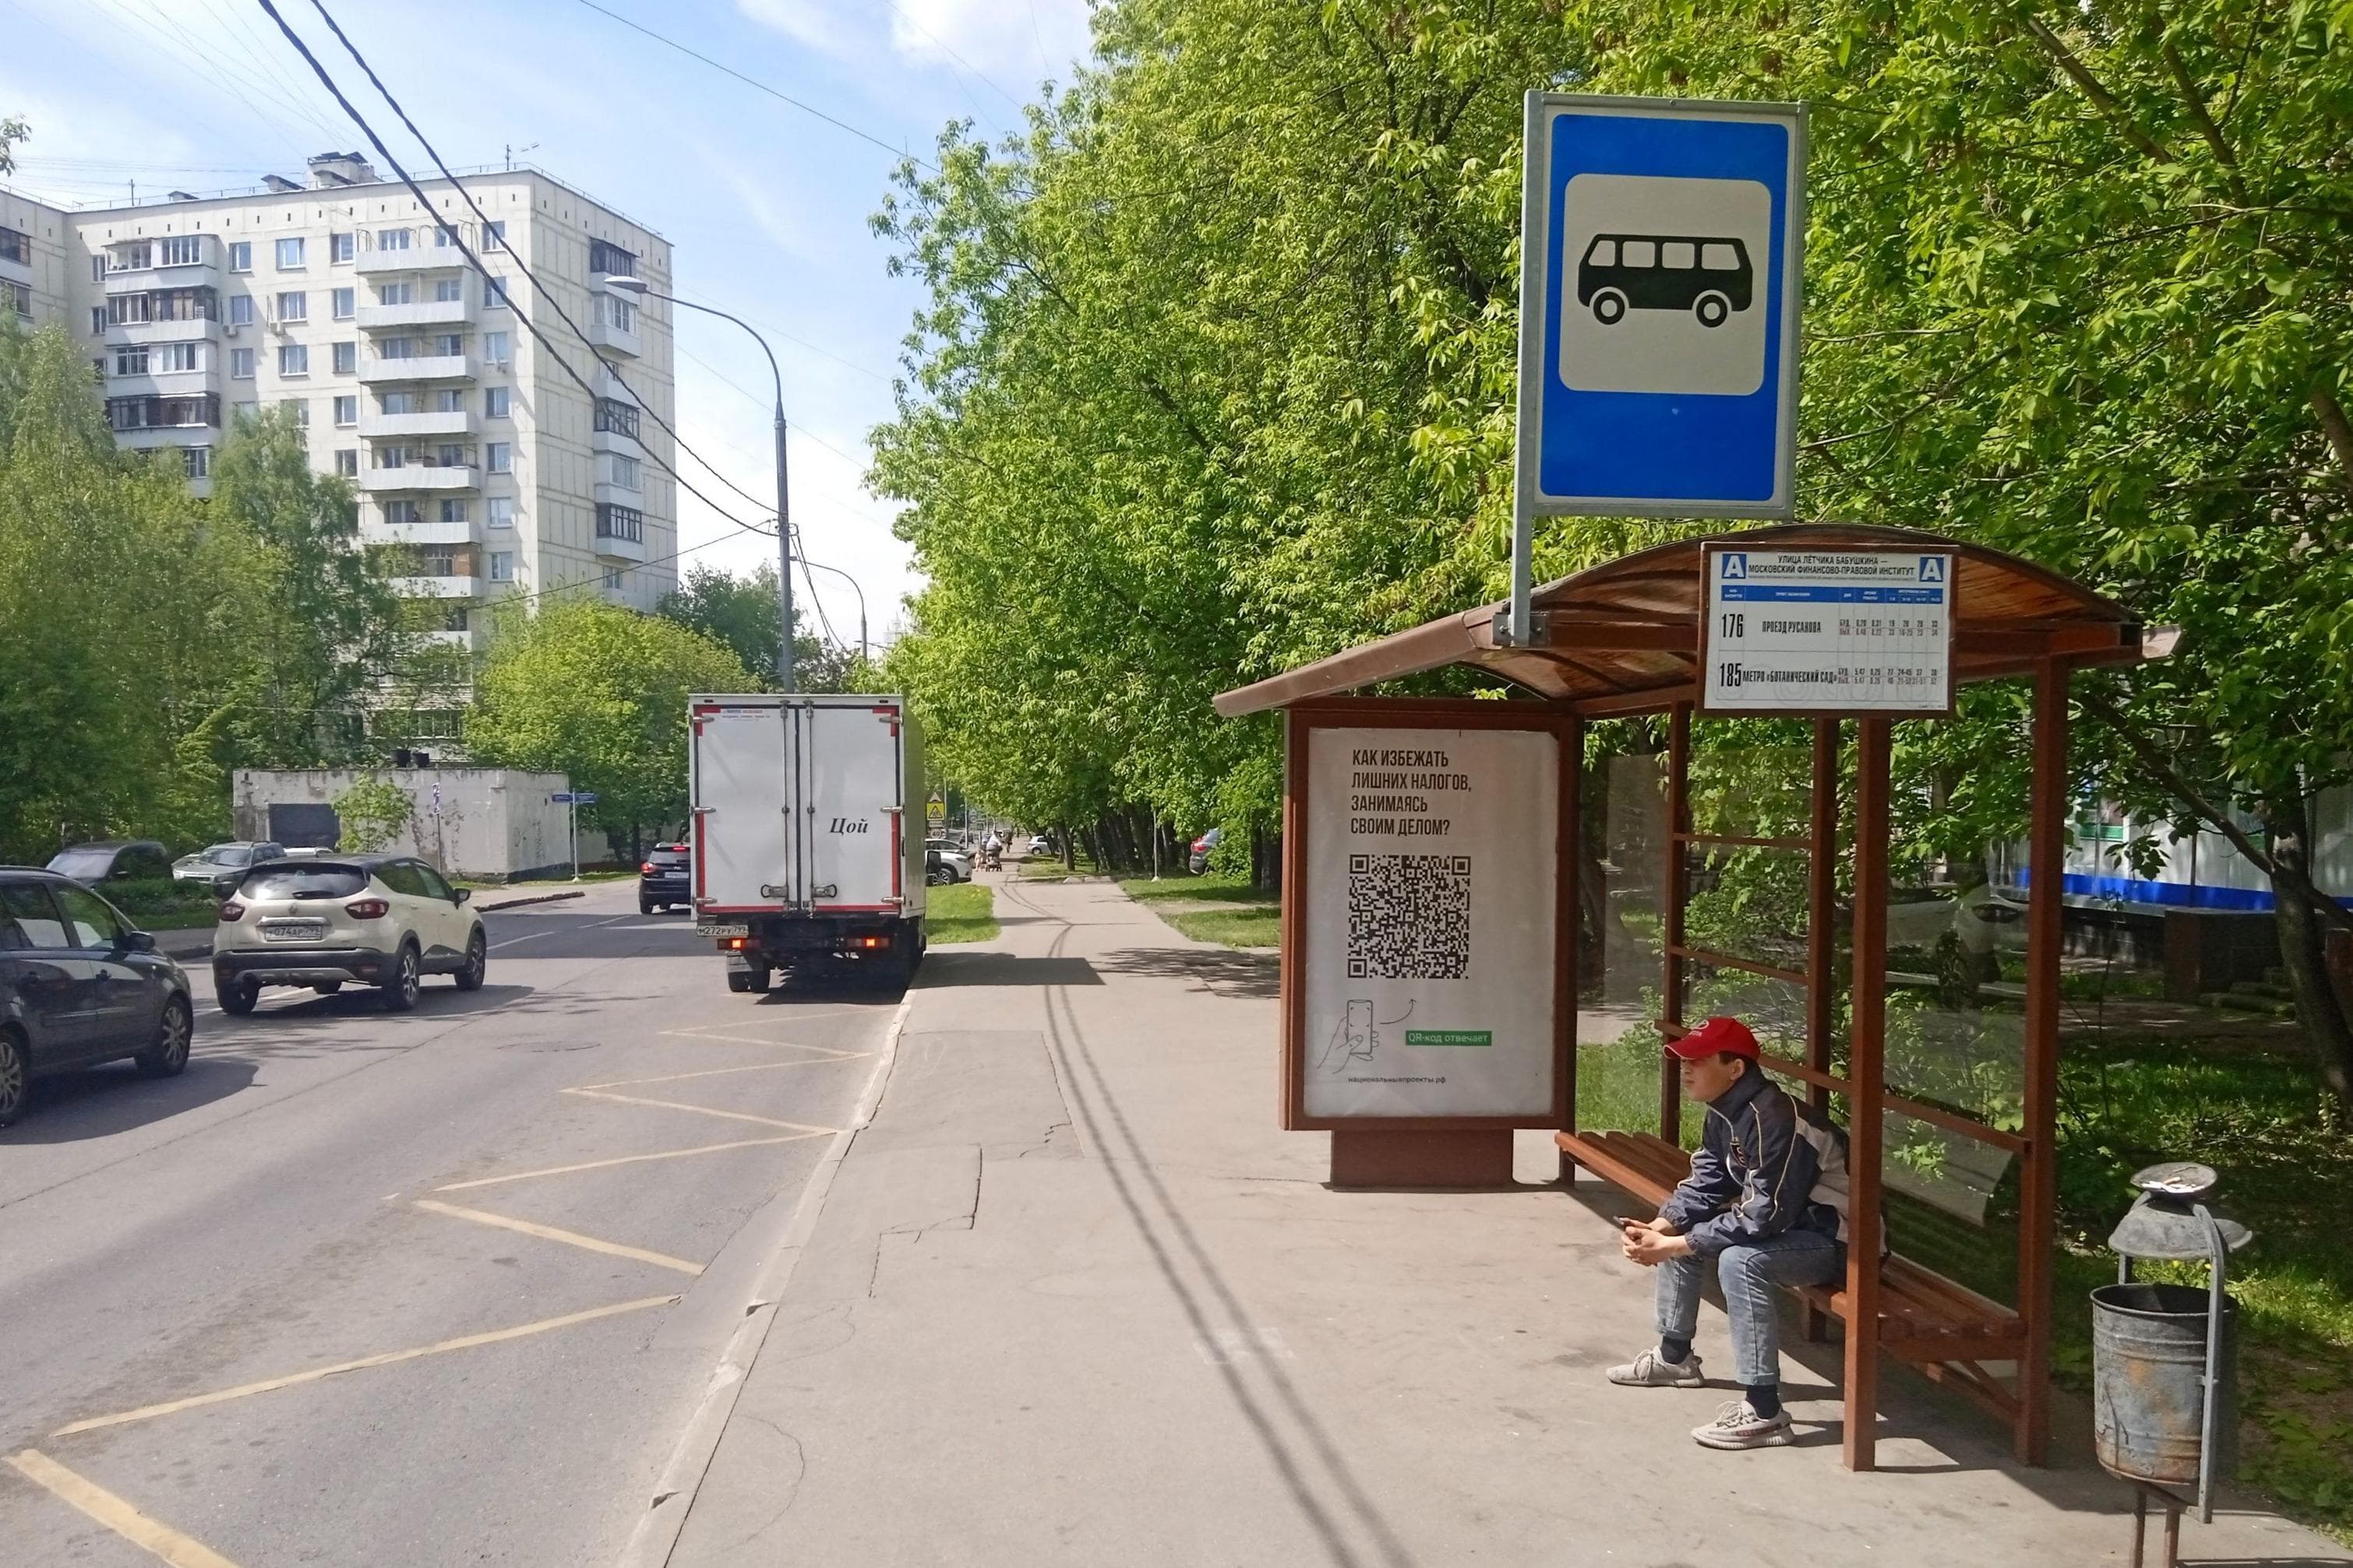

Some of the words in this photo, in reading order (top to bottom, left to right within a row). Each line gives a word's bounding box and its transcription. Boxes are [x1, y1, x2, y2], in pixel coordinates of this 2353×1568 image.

[1723, 555, 1744, 577] А
[1778, 555, 1802, 564] УЛИЦА
[1803, 555, 1834, 564] ЛЁТЧИКА
[1836, 556, 1879, 566] БАБУШКИНА
[1921, 558, 1942, 580] А
[1748, 564, 1795, 574] МОСКОВСКИЙ
[1797, 565, 1877, 575] ФИНАНСОВО-ПРАВОВОЙ
[1879, 567, 1914, 576] ИНСТИТУТ
[1722, 614, 1744, 638] 176
[1762, 621, 1787, 634] ПРОЕЗД
[1788, 622, 1822, 633] РУСАНОВА
[1720, 663, 1741, 687] 185
[1742, 671, 1765, 682] МЕТРО
[1766, 670, 1819, 682] «БОТАНИЧЕСКИЙ
[1353, 749, 1378, 766] КАК
[1381, 749, 1448, 768] ИЗБЕЖАТЬ
[1351, 773, 1407, 790] ЛИШНИХ
[1411, 773, 1472, 792] НАЛОГОВ,
[1351, 795, 1427, 813] ЗАНИМАЯСЬ
[830, 817, 869, 834] Цой
[1351, 818, 1395, 836] СВОИМ
[1398, 818, 1450, 837] ДЕЛОМ?
[1408, 1033, 1442, 1044] QR-код
